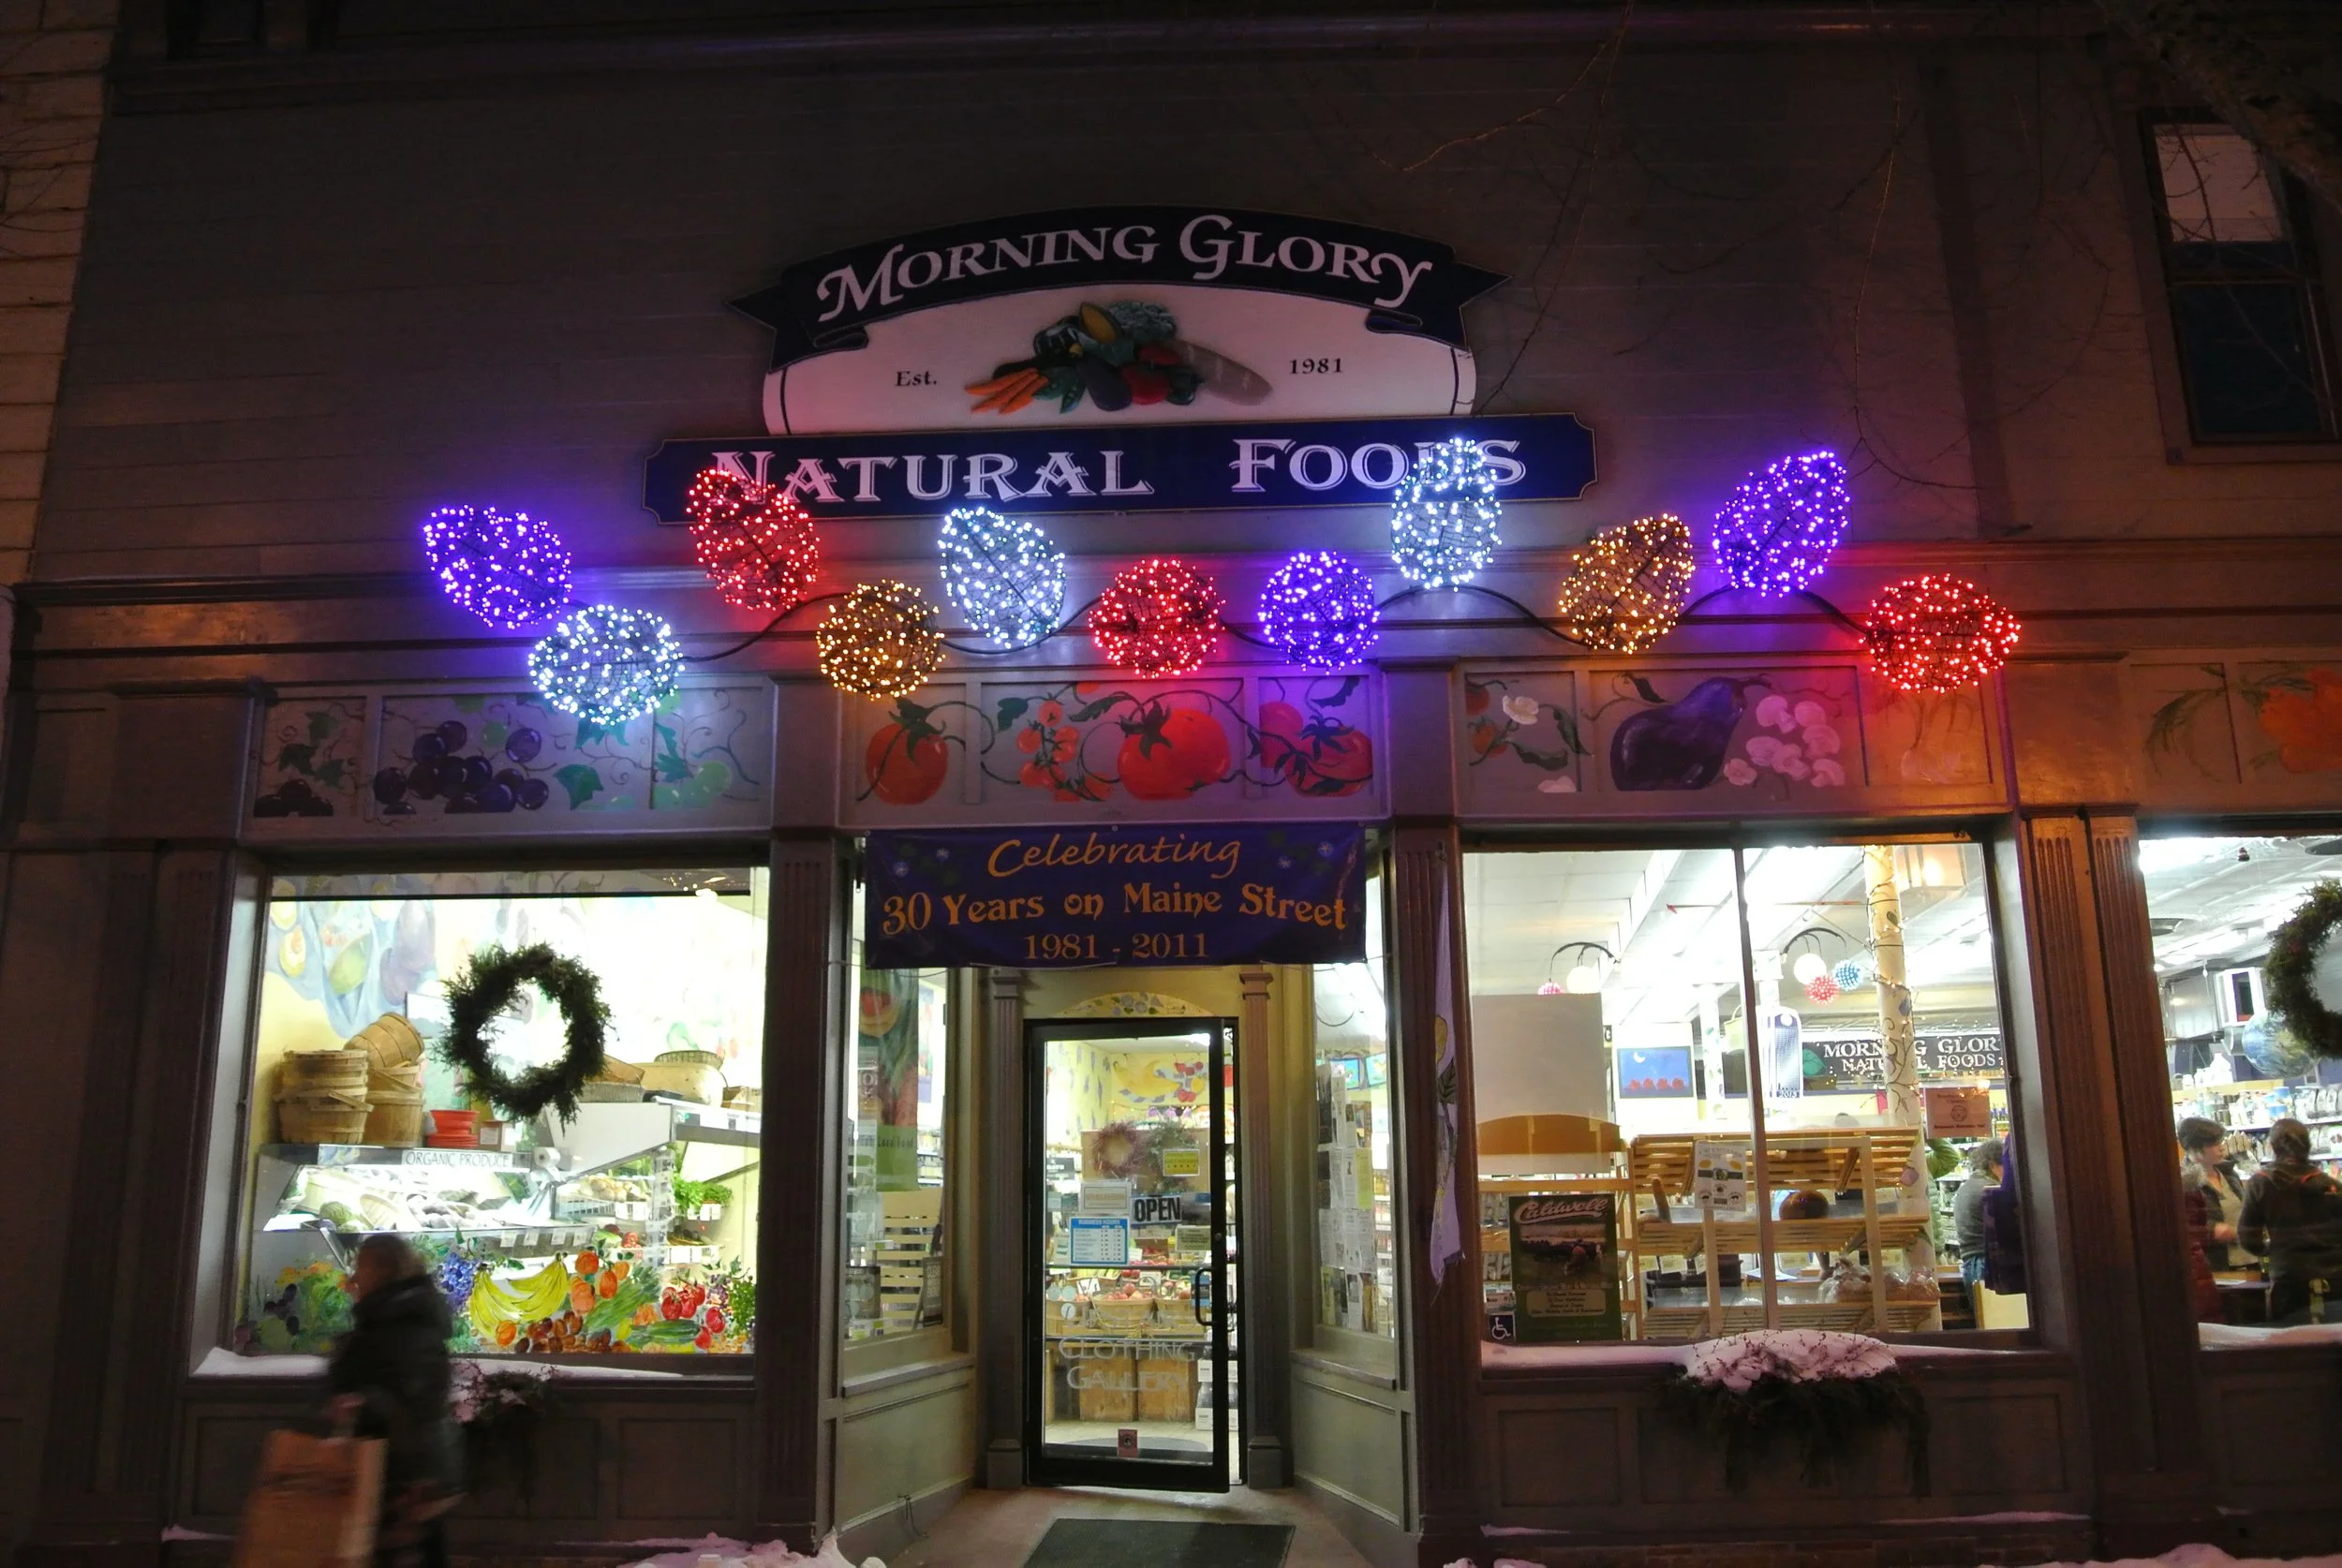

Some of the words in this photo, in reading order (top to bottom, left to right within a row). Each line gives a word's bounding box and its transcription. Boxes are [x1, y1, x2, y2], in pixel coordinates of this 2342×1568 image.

[817, 226, 1160, 322] MORNING
[1178, 214, 1433, 308] GLORY
[896, 371, 937, 387] Est.
[1290, 358, 1343, 375] 1981
[711, 450, 1154, 504] NATURAL
[987, 833, 1241, 878] Celebrating
[882, 892, 932, 935] 30
[941, 892, 1045, 925] Years
[1064, 893, 1104, 922] on
[1124, 881, 1223, 914] Maine
[1239, 882, 1348, 930] Street
[1024, 933, 1099, 960] 1981
[1132, 932, 1209, 959] 2011
[1937, 1036, 2000, 1054] GLOR
[1937, 1054, 1996, 1069] FOODS
[406, 1151, 455, 1167] ORGANIC
[459, 1153, 510, 1168] PRODUCE
[1134, 1196, 1181, 1222] OPEN
[1514, 1198, 1609, 1224] Caldwell
[1059, 1337, 1195, 1362] CLOTHING
[1066, 1366, 1187, 1392] GALLERY
